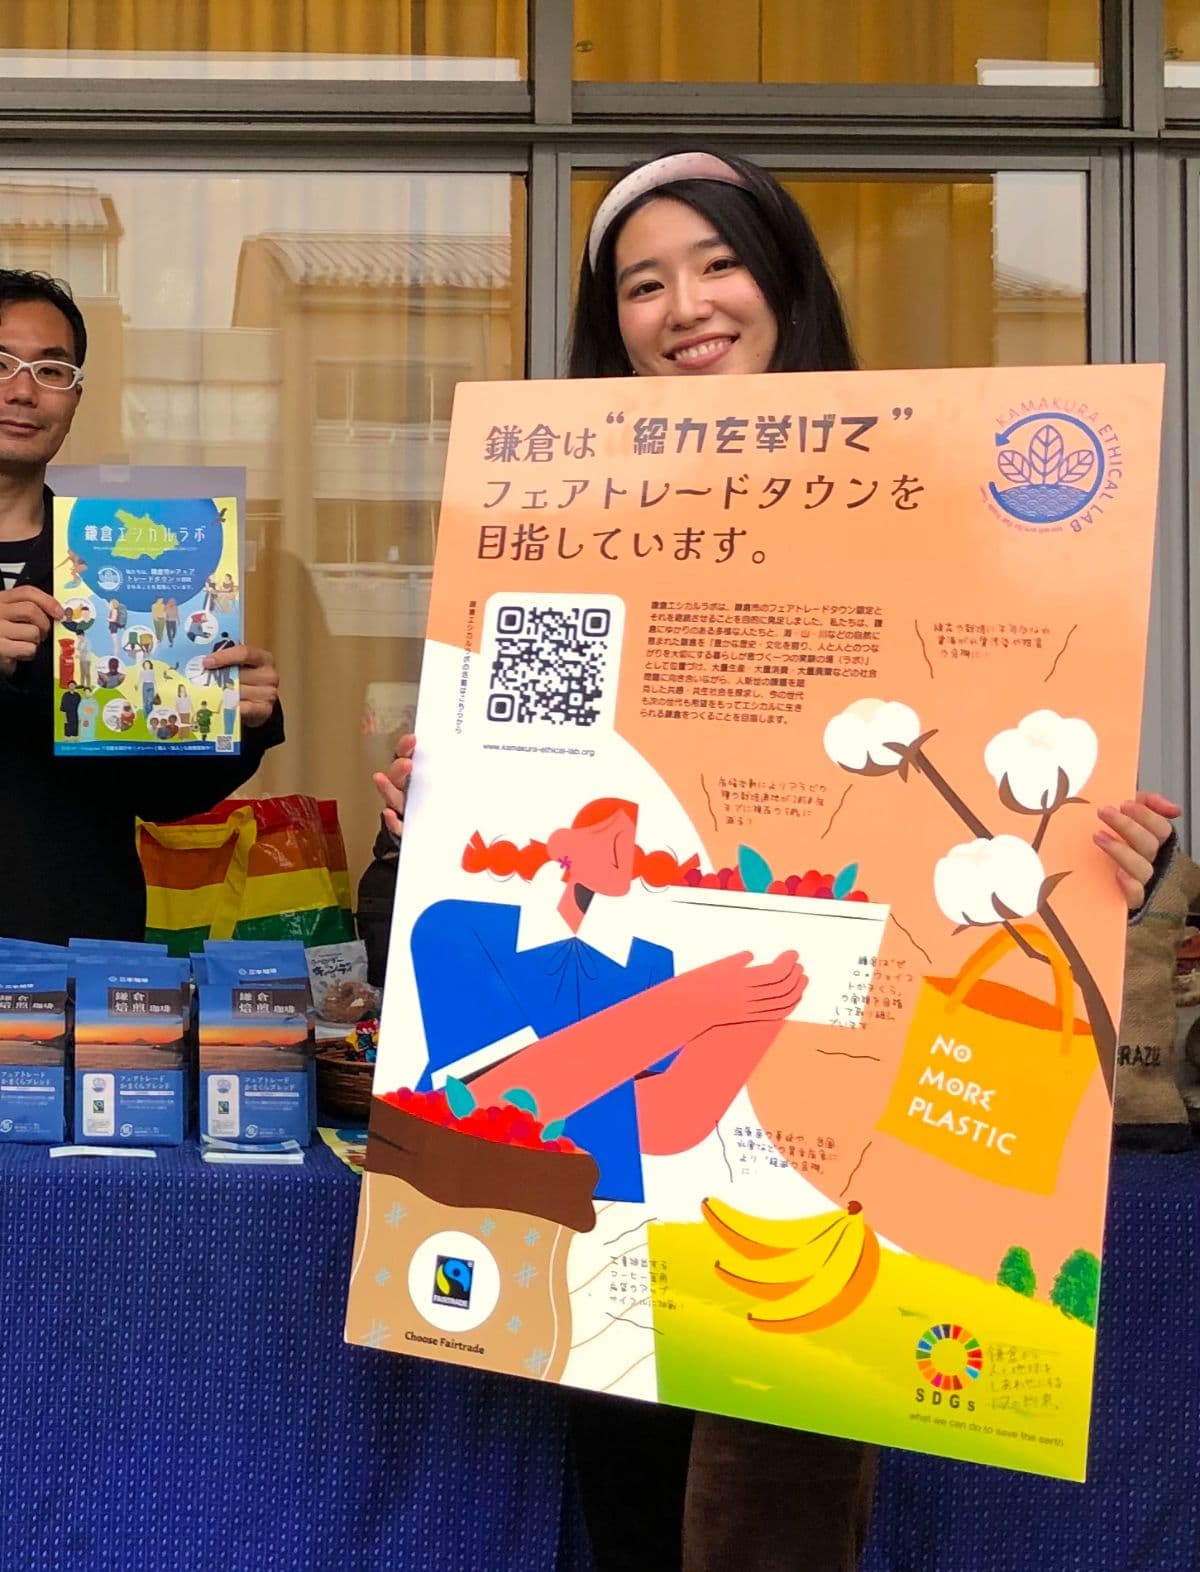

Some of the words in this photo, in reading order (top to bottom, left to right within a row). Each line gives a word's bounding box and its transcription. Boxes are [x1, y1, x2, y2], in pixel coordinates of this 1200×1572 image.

[1098, 423, 1123, 500] ETHICAL
[483, 474, 925, 511] フェアトレードタウンを
[84, 525, 206, 542] 鎌倉エシカルラボ
[1070, 504, 1104, 533] LAB
[477, 524, 767, 565] 目指しています。
[929, 1034, 973, 1064] NO
[918, 1066, 997, 1112] MORE
[907, 1097, 1017, 1156] PLASTIC
[405, 1330, 438, 1347] Choose
[439, 1337, 485, 1355] Fairtrade
[909, 1412, 931, 1423] what
[949, 1420, 966, 1430] can
[968, 1422, 982, 1432] do
[983, 1425, 993, 1434] to
[995, 1429, 1018, 1439] save
[1020, 1431, 1036, 1442] the
[1039, 1436, 1064, 1447] earth
